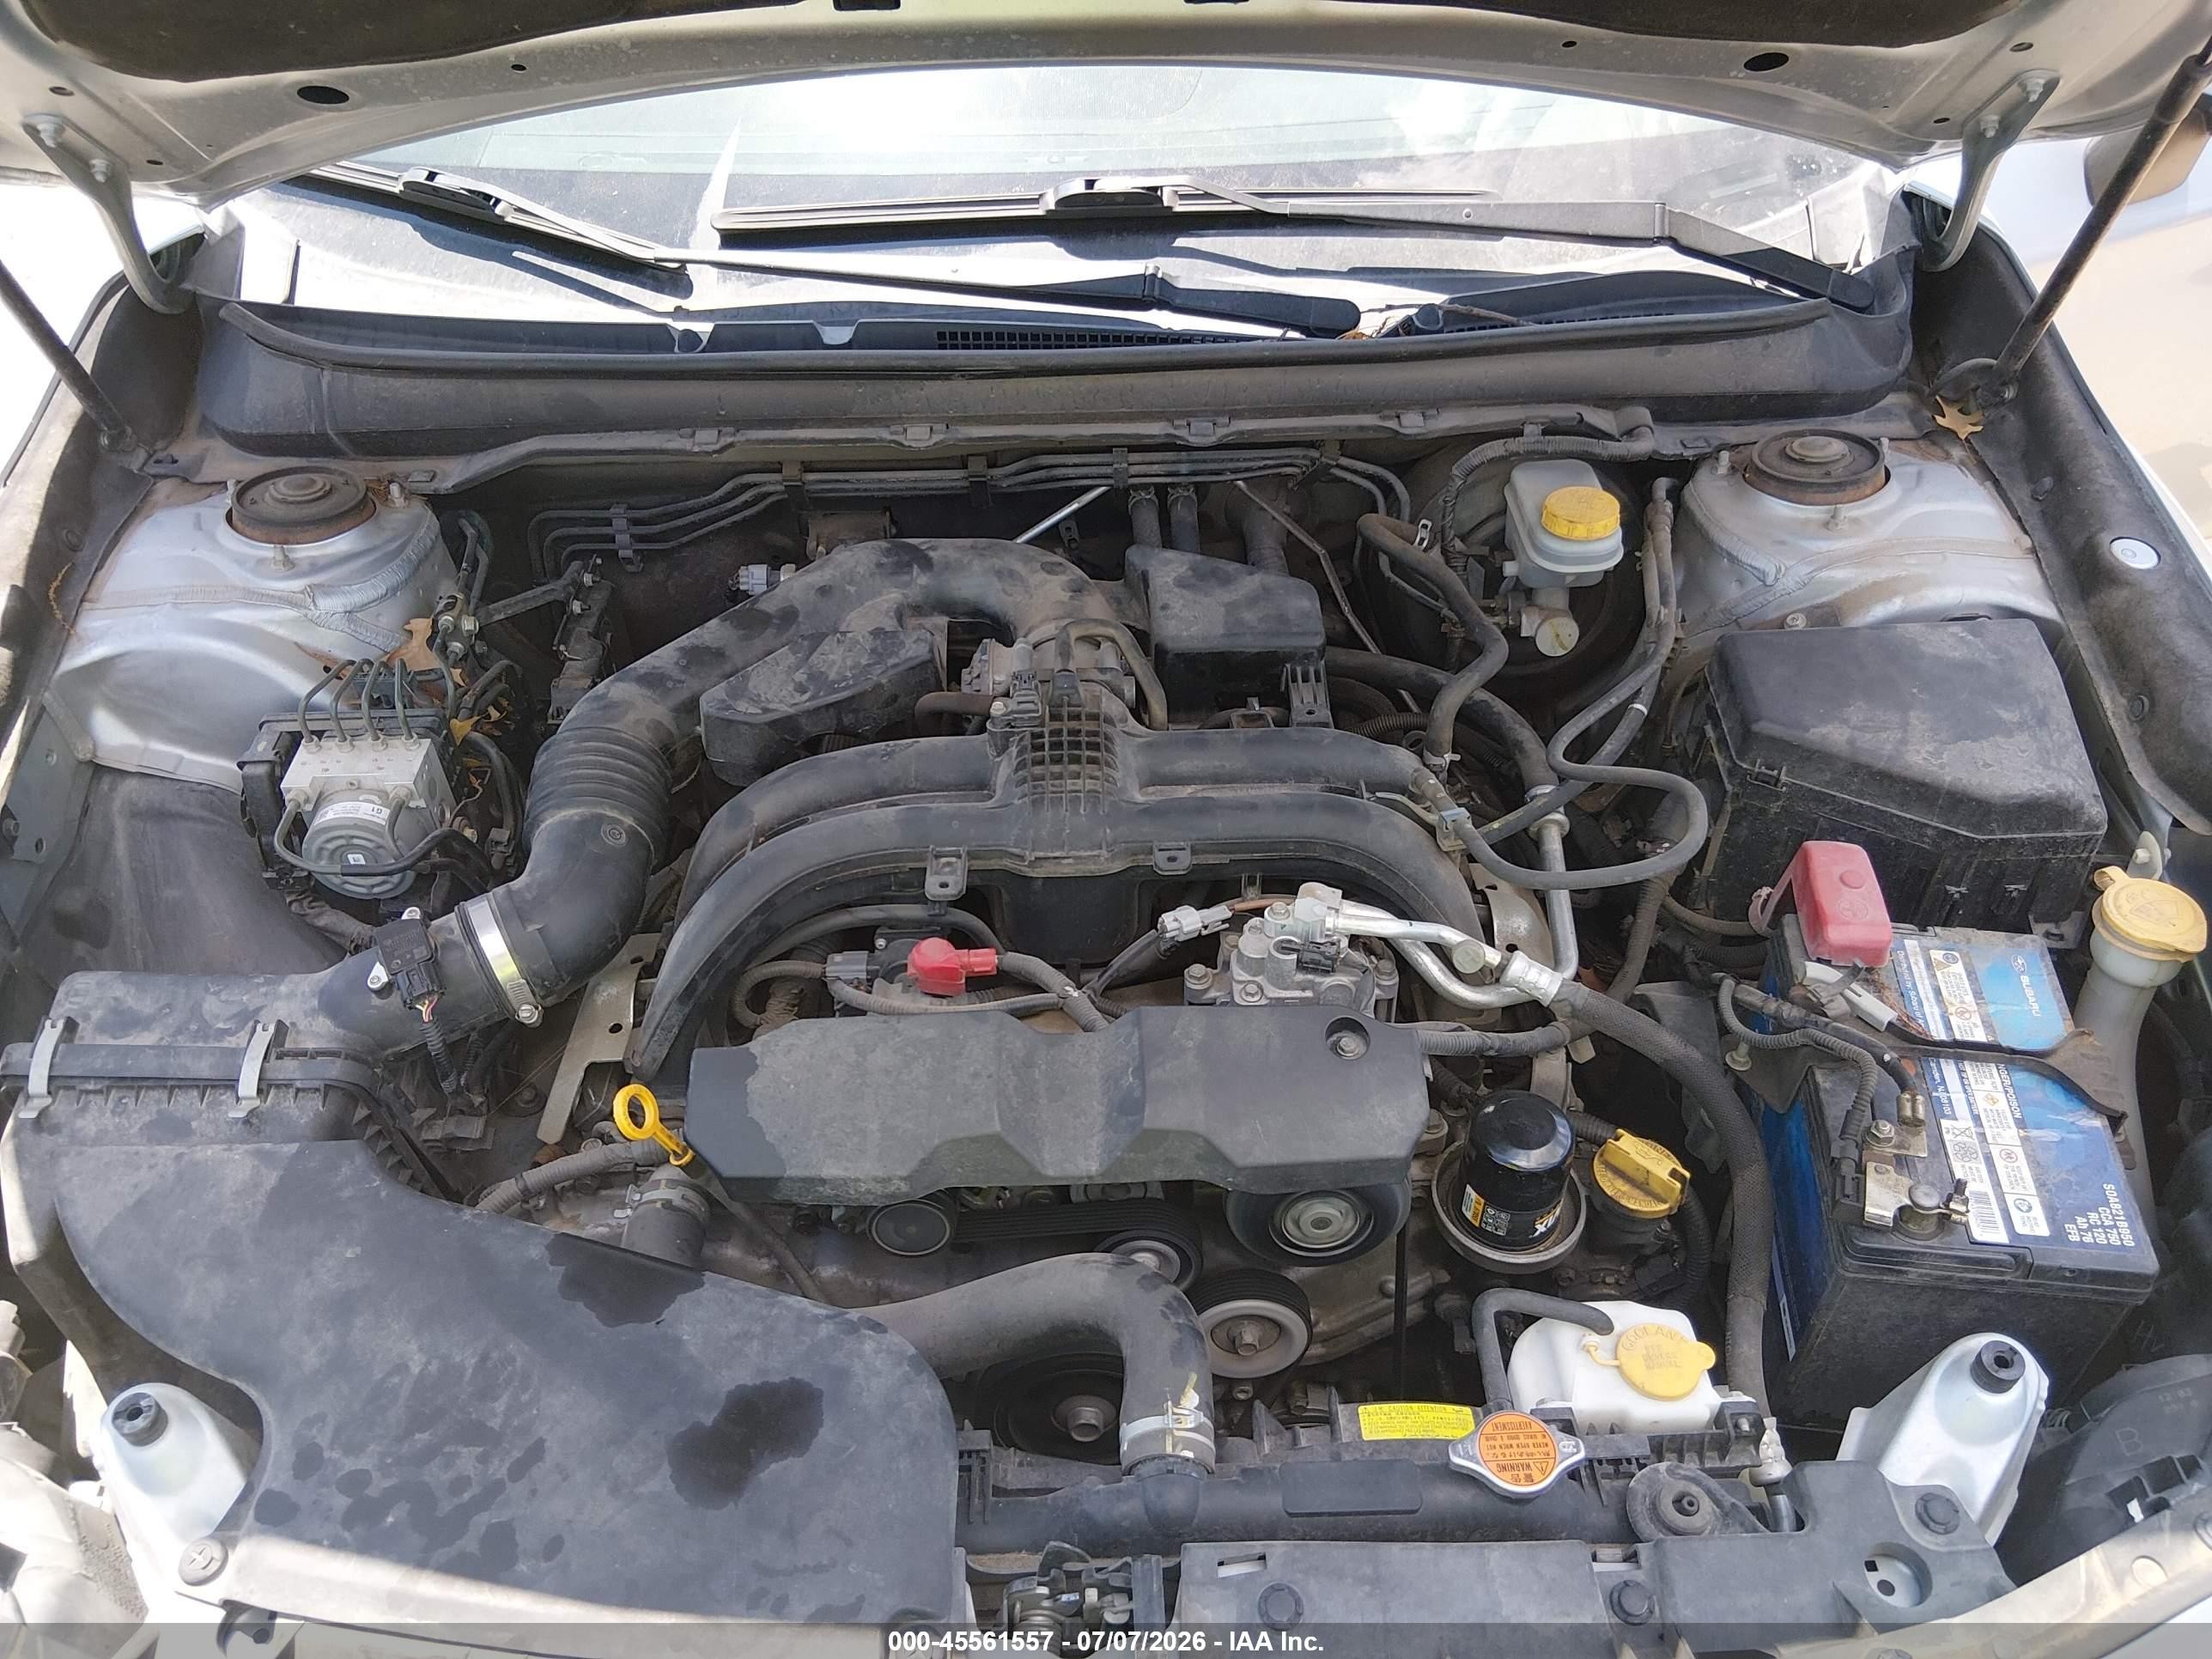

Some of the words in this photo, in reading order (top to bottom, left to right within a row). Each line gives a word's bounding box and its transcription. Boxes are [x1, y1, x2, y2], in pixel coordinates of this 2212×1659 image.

[1908, 991, 1920, 1010] Subaru
[2020, 975, 2041, 1016] SUBARU
[1996, 1063, 2022, 1118] NGER/POISON
[1628, 1195, 1662, 1208] MANUAL
[2074, 1216, 2089, 1229] Ah
[2086, 1212, 2101, 1225] RC
[2097, 1207, 2114, 1225] CCA
[2063, 1224, 2081, 1241] EFB
[2092, 1227, 2107, 1243] 120
[2105, 1228, 2121, 1245] 750
[1496, 1462, 1532, 1472] WARNING
